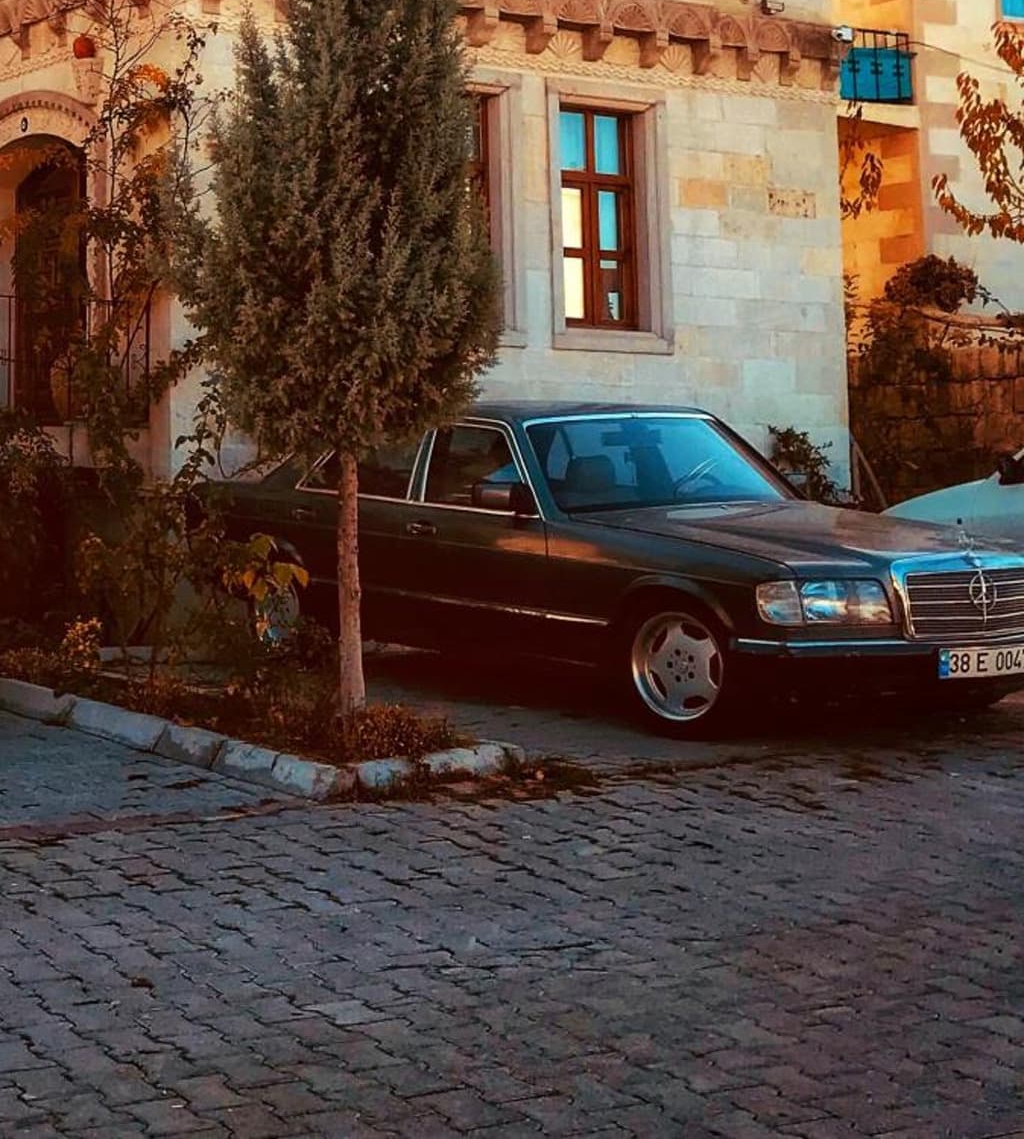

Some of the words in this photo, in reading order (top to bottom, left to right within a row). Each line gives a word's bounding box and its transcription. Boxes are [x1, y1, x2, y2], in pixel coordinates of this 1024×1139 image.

[949, 653, 970, 673] 38
[977, 653, 989, 672] E
[996, 649, 1024, 671] 004
